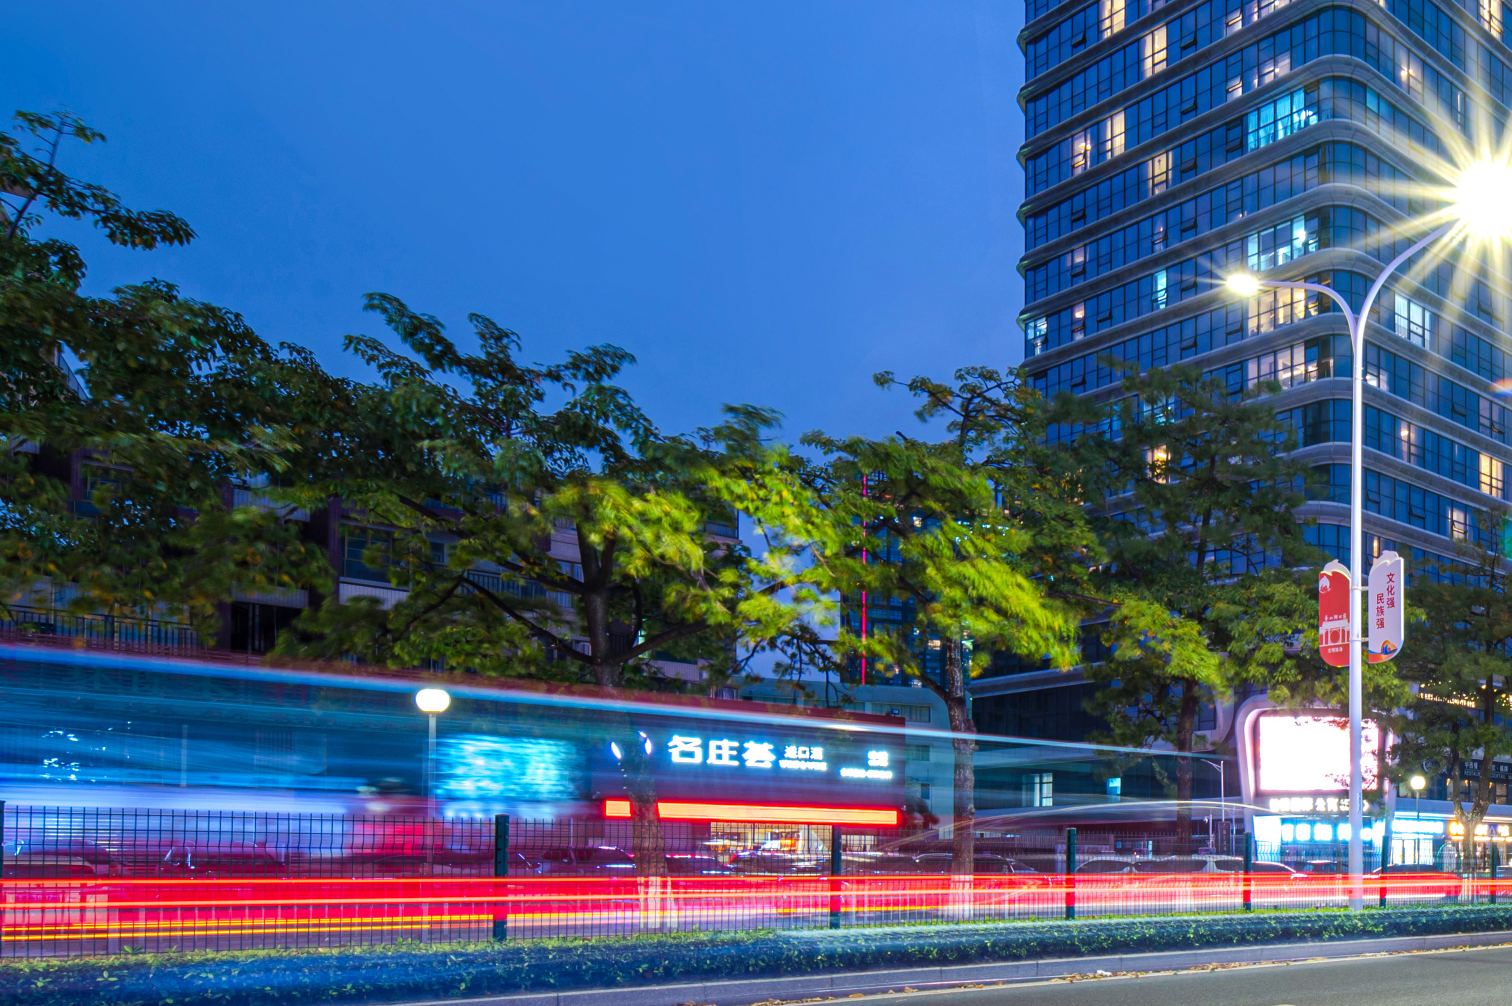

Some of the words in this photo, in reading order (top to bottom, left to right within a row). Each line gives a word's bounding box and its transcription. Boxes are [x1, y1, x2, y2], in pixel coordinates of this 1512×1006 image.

[1386, 572, 1396, 609] 文化强
[1376, 593, 1385, 629] 民族强
